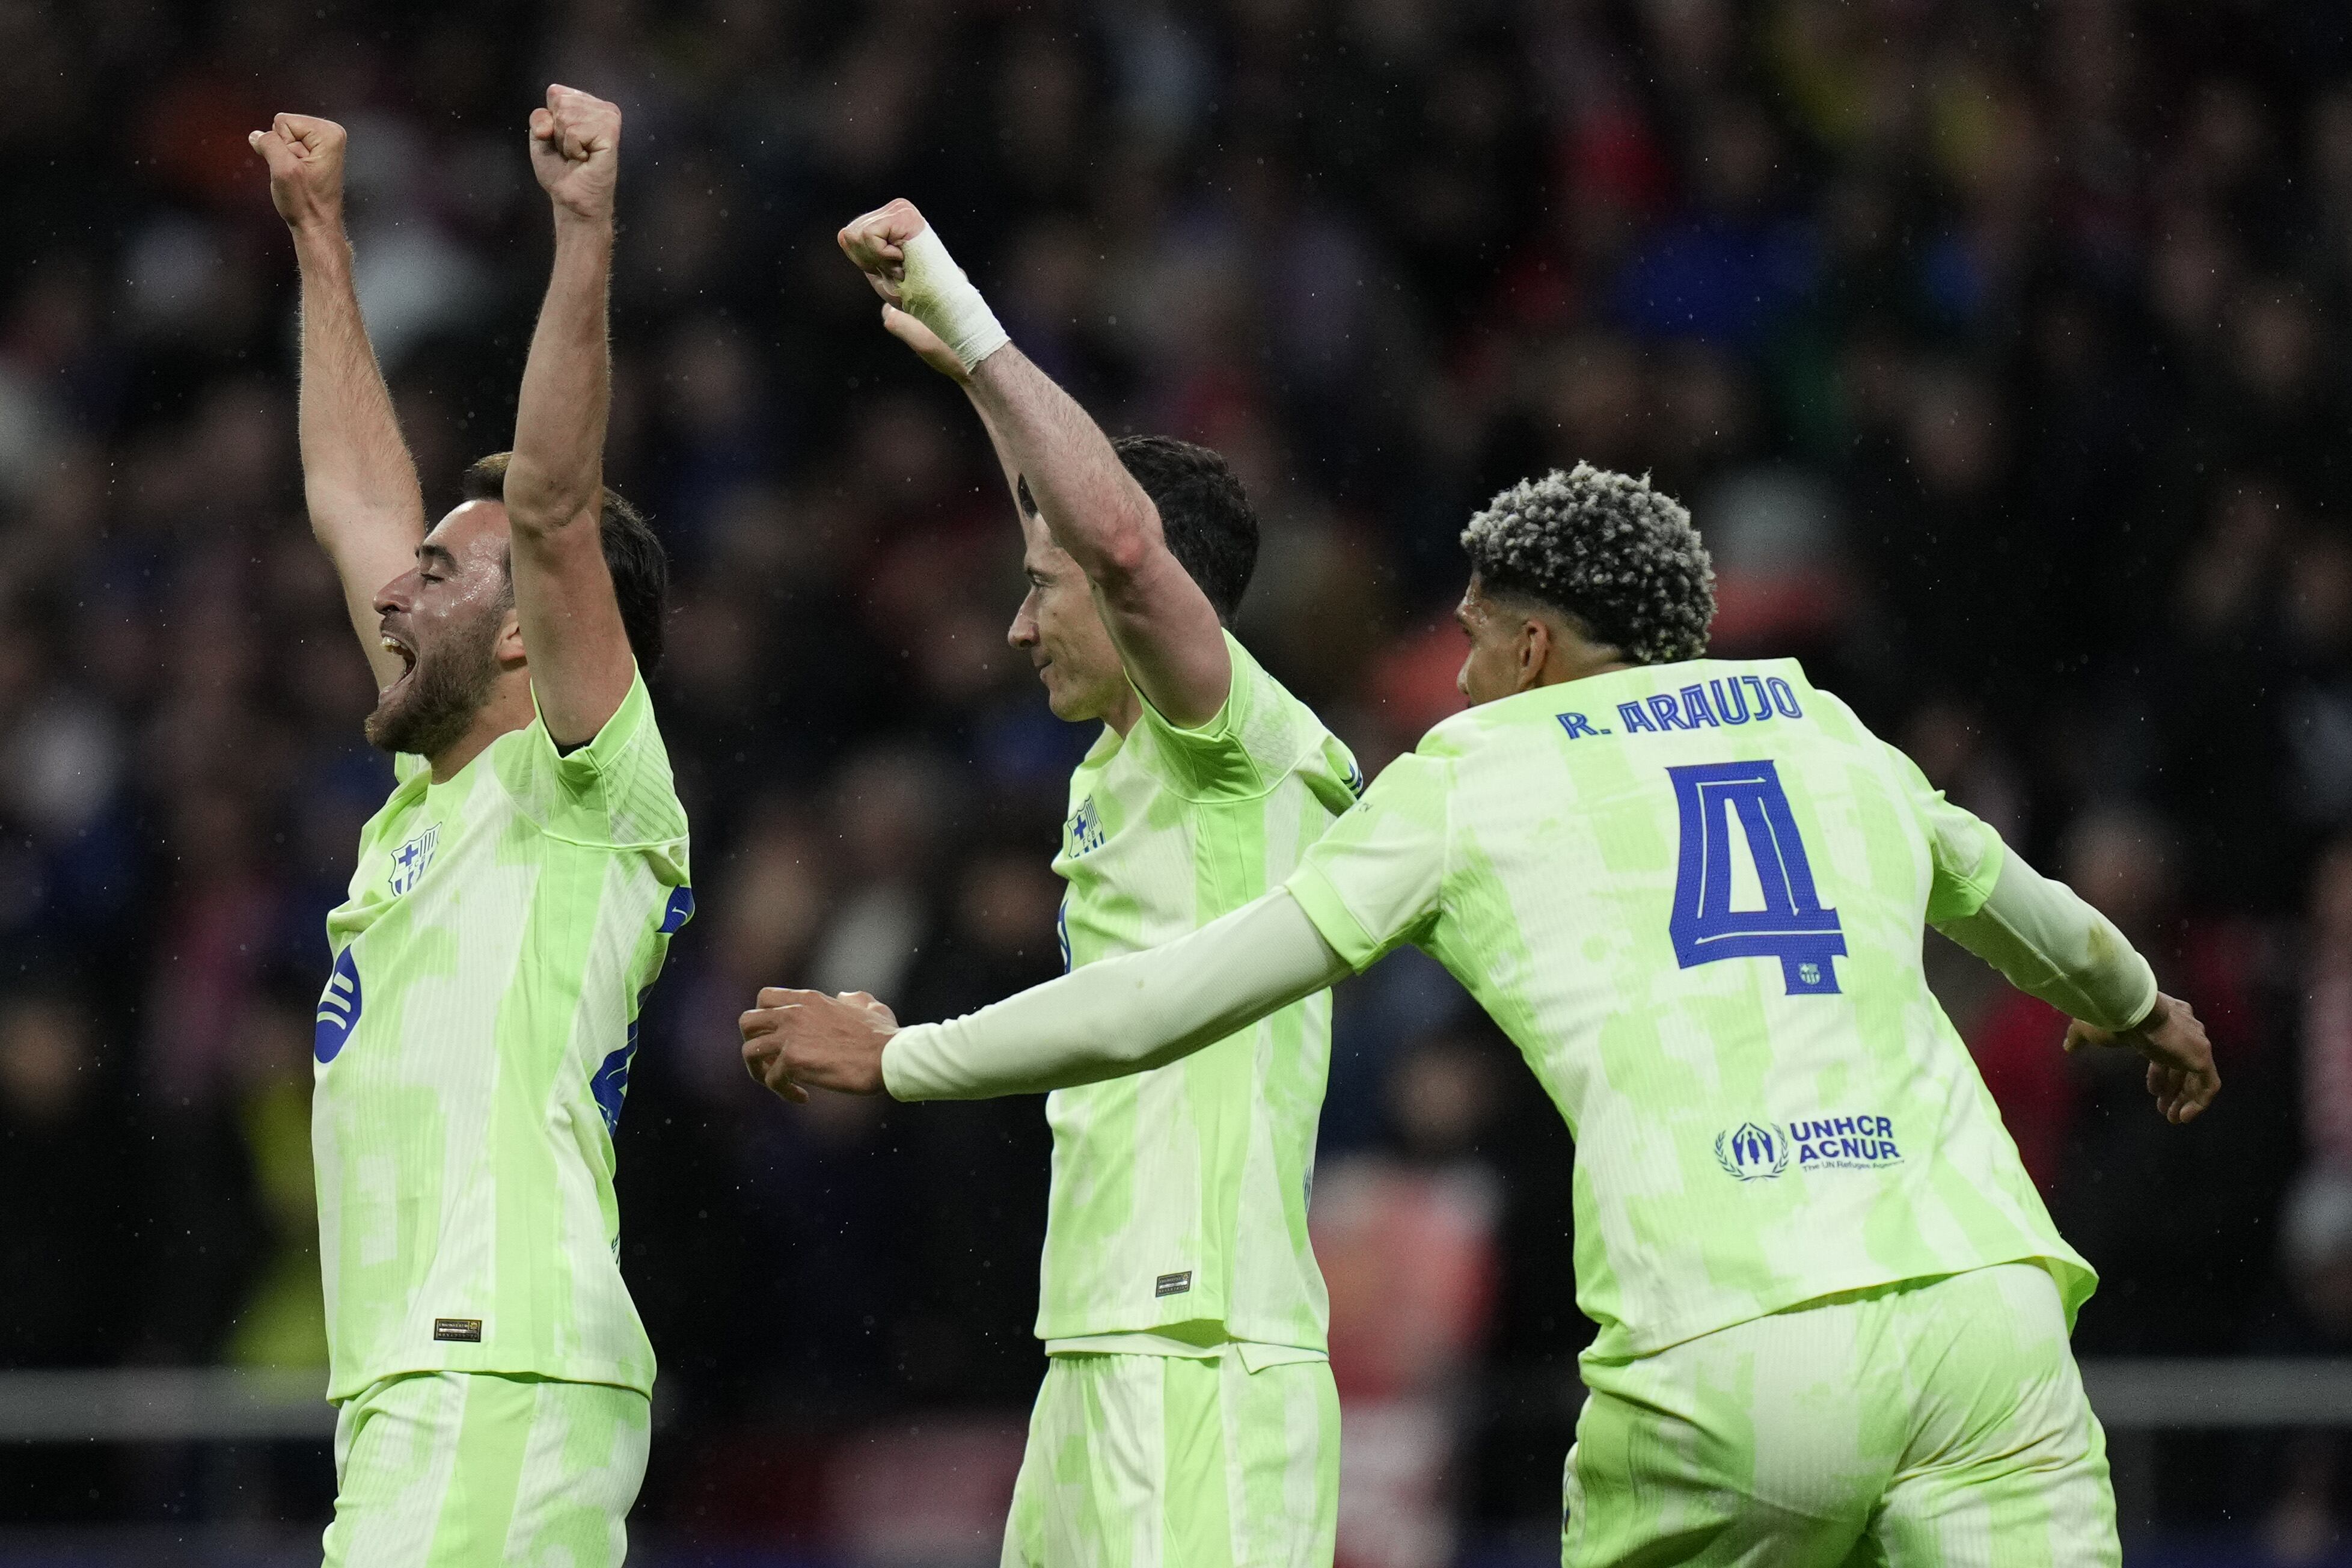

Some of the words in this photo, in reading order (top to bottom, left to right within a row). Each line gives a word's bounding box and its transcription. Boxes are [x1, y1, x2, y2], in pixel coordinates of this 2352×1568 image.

[1555, 712, 1612, 740] R.
[1617, 675, 1803, 733] ARAUJO
[1664, 759, 1848, 996] 4
[1790, 1115, 1893, 1142] UNHCR
[1799, 1138, 1900, 1163] ACNUR
[1821, 1160, 1835, 1169] UN
